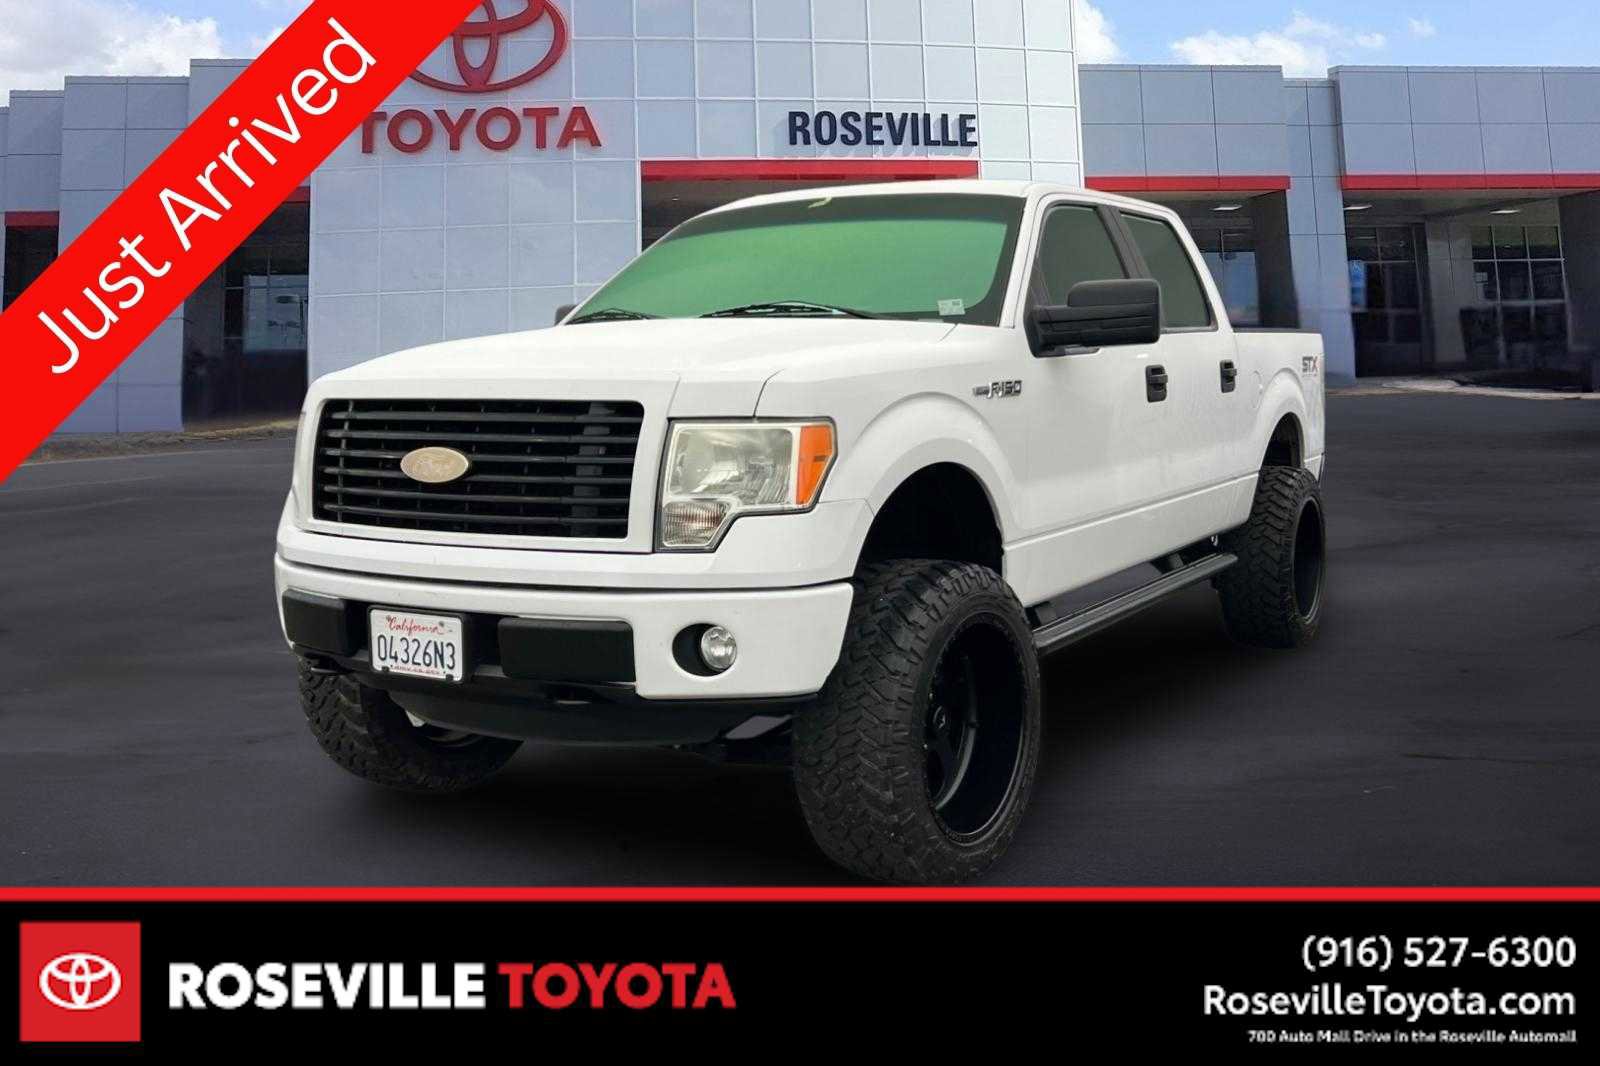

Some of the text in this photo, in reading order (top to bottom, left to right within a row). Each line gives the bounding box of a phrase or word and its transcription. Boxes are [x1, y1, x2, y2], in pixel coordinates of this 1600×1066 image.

[361, 106, 602, 154] TOYOTA
[788, 111, 978, 147] ROSEVILLE
[1302, 355, 1318, 373] STX
[386, 615, 444, 636] California
[377, 634, 456, 670] 04326N3
